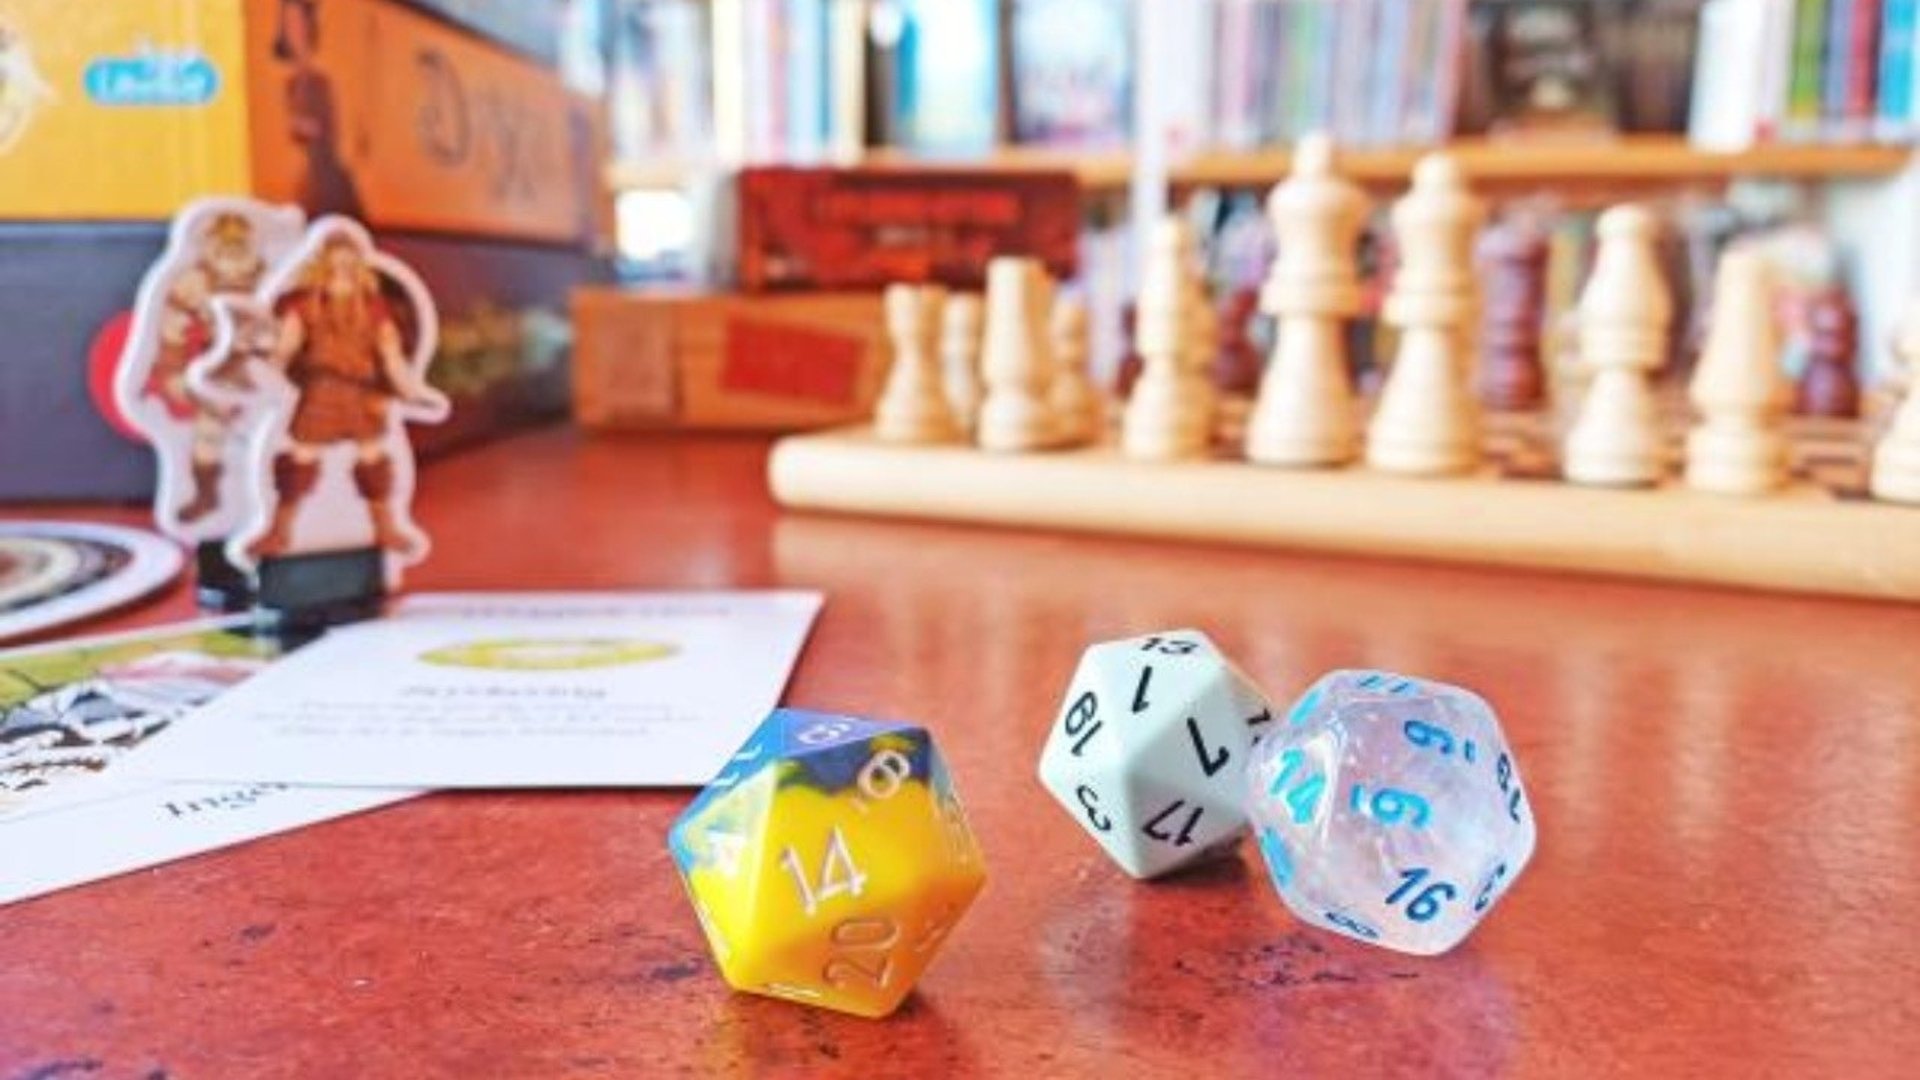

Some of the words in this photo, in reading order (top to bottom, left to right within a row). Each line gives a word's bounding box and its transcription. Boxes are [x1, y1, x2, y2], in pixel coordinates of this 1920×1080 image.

[1132, 666, 1152, 713] 1
[1187, 717, 1230, 777] 7
[1076, 785, 1112, 832] 3
[1268, 749, 1327, 824] 14
[1142, 799, 1203, 847] 17
[781, 825, 868, 917] 14
[1385, 867, 1457, 922] 16
[822, 917, 901, 988] 20
